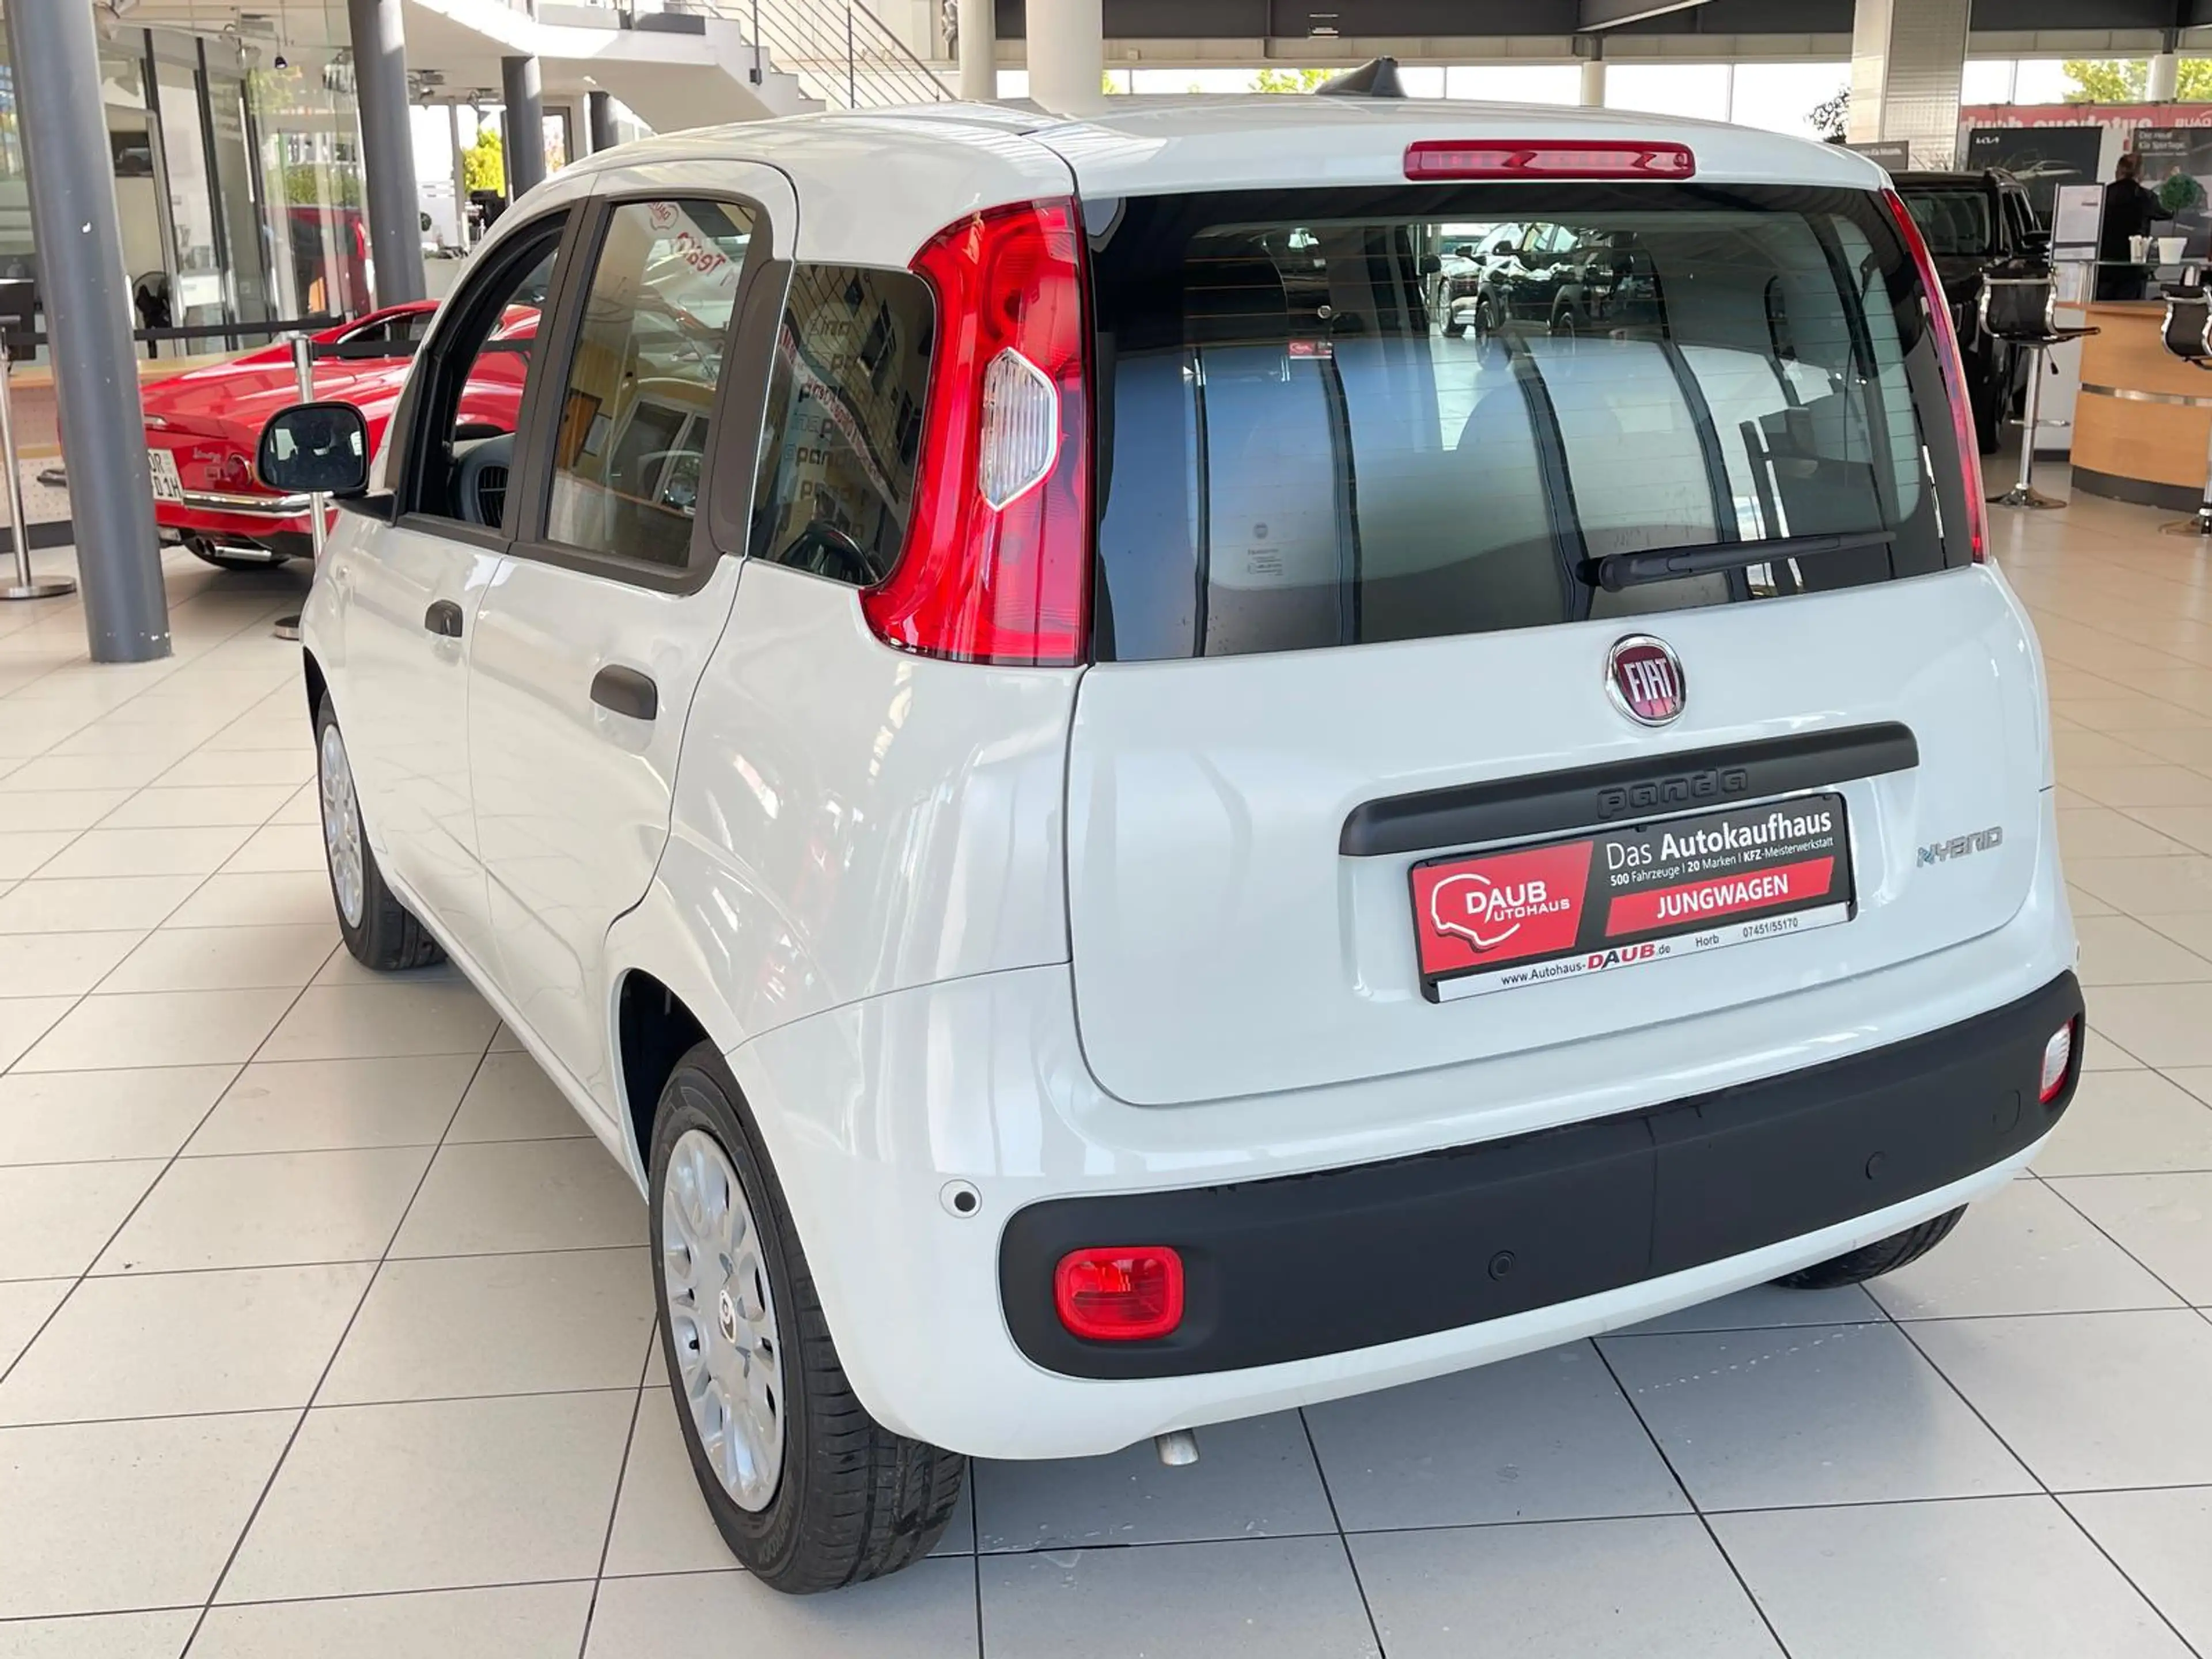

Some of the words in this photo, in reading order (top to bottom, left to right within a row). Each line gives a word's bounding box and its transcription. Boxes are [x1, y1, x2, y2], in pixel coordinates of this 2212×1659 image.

[1623, 658, 1672, 703] FIAT
[1597, 768, 1748, 819] panda
[1606, 842, 1653, 870] Das
[1660, 811, 1832, 862] Autokaufhaus
[1610, 873, 1630, 887] 500
[1631, 865, 1680, 883] Fahrzeuge
[1688, 860, 1700, 873] 20
[1703, 854, 1736, 869] Marken
[1743, 836, 1834, 863] KFZ-Meisterwerkstatt
[1465, 881, 1547, 924] DAUB
[1657, 873, 1788, 919] JUNGWAGEN
[1696, 934, 1719, 948] Horb
[1743, 917, 1799, 938] 07451/55170
